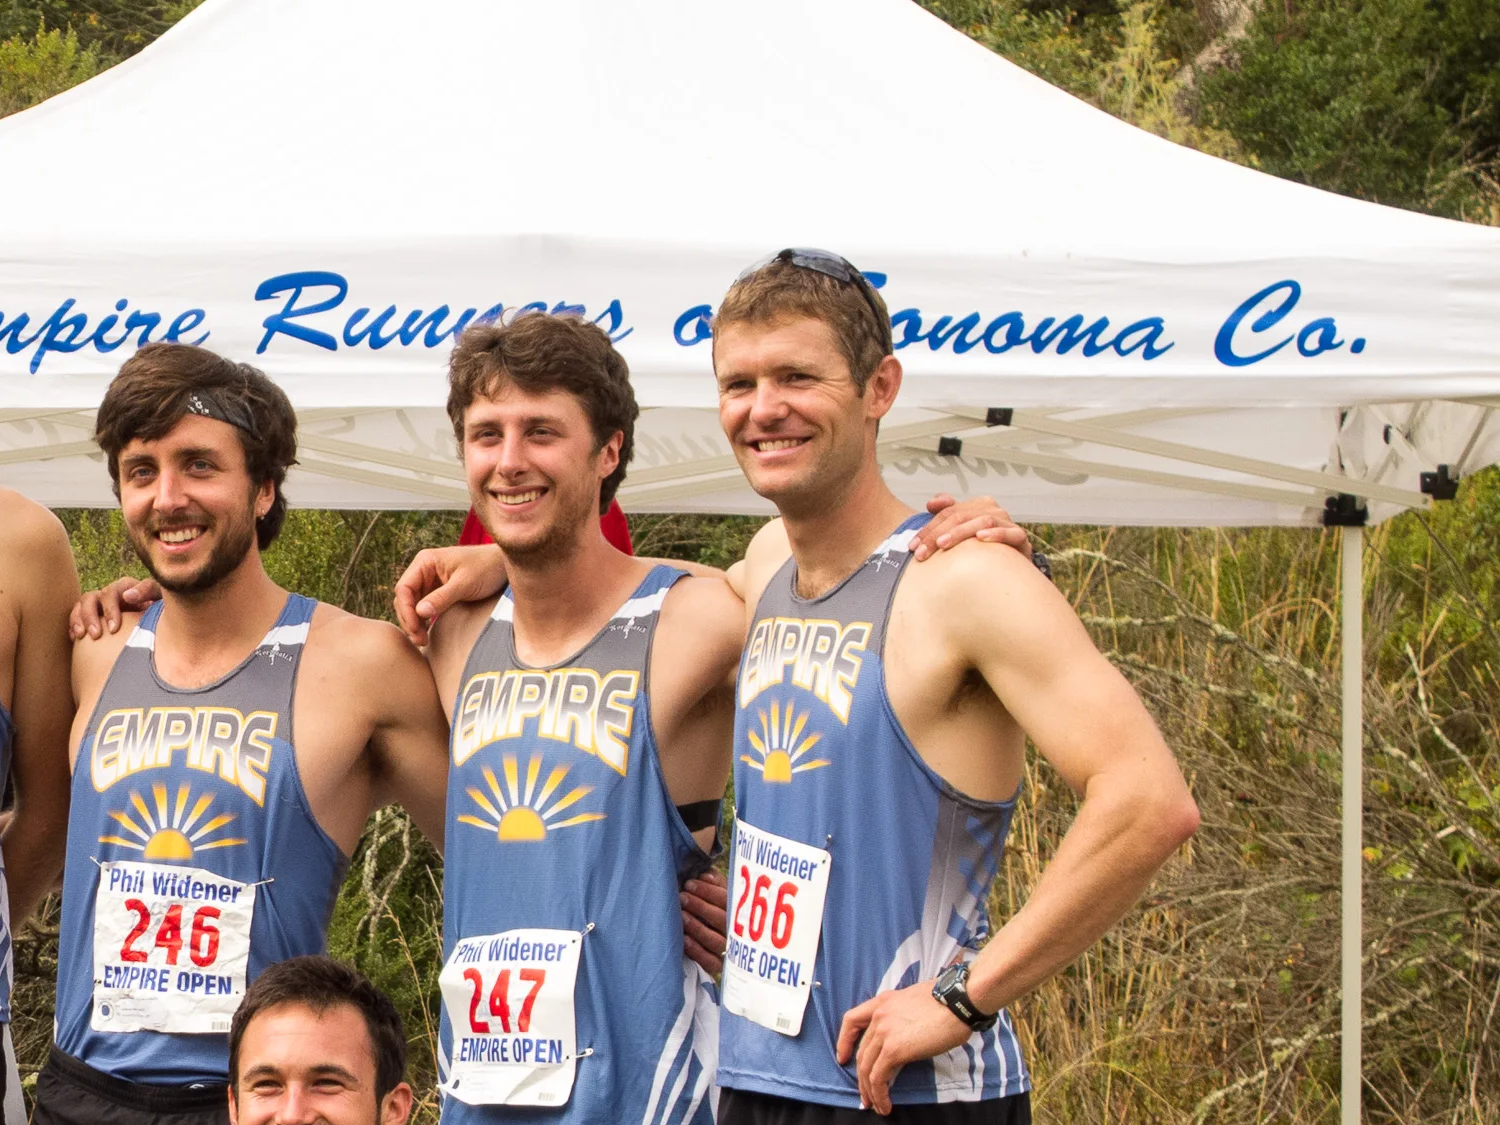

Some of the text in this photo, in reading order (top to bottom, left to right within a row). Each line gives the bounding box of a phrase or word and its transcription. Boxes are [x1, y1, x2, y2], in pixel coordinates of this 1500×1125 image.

[673, 304, 713, 347] o
[863, 274, 1175, 358] onoma
[1214, 280, 1367, 367] Co.
[740, 618, 873, 725] EMPIRE
[453, 668, 640, 776] EMPIRE
[91, 707, 278, 806] EMPIRE
[109, 869, 242, 903] Phil Widener
[756, 839, 818, 881] Widener
[120, 898, 219, 967] 246
[734, 865, 799, 949] 266
[104, 966, 231, 995] EMPIRE OPEN
[458, 939, 567, 965] Phil Widener
[759, 951, 801, 987] OPEN
[464, 968, 545, 1034] 247
[460, 1036, 562, 1063] EMPIRE OPEN
